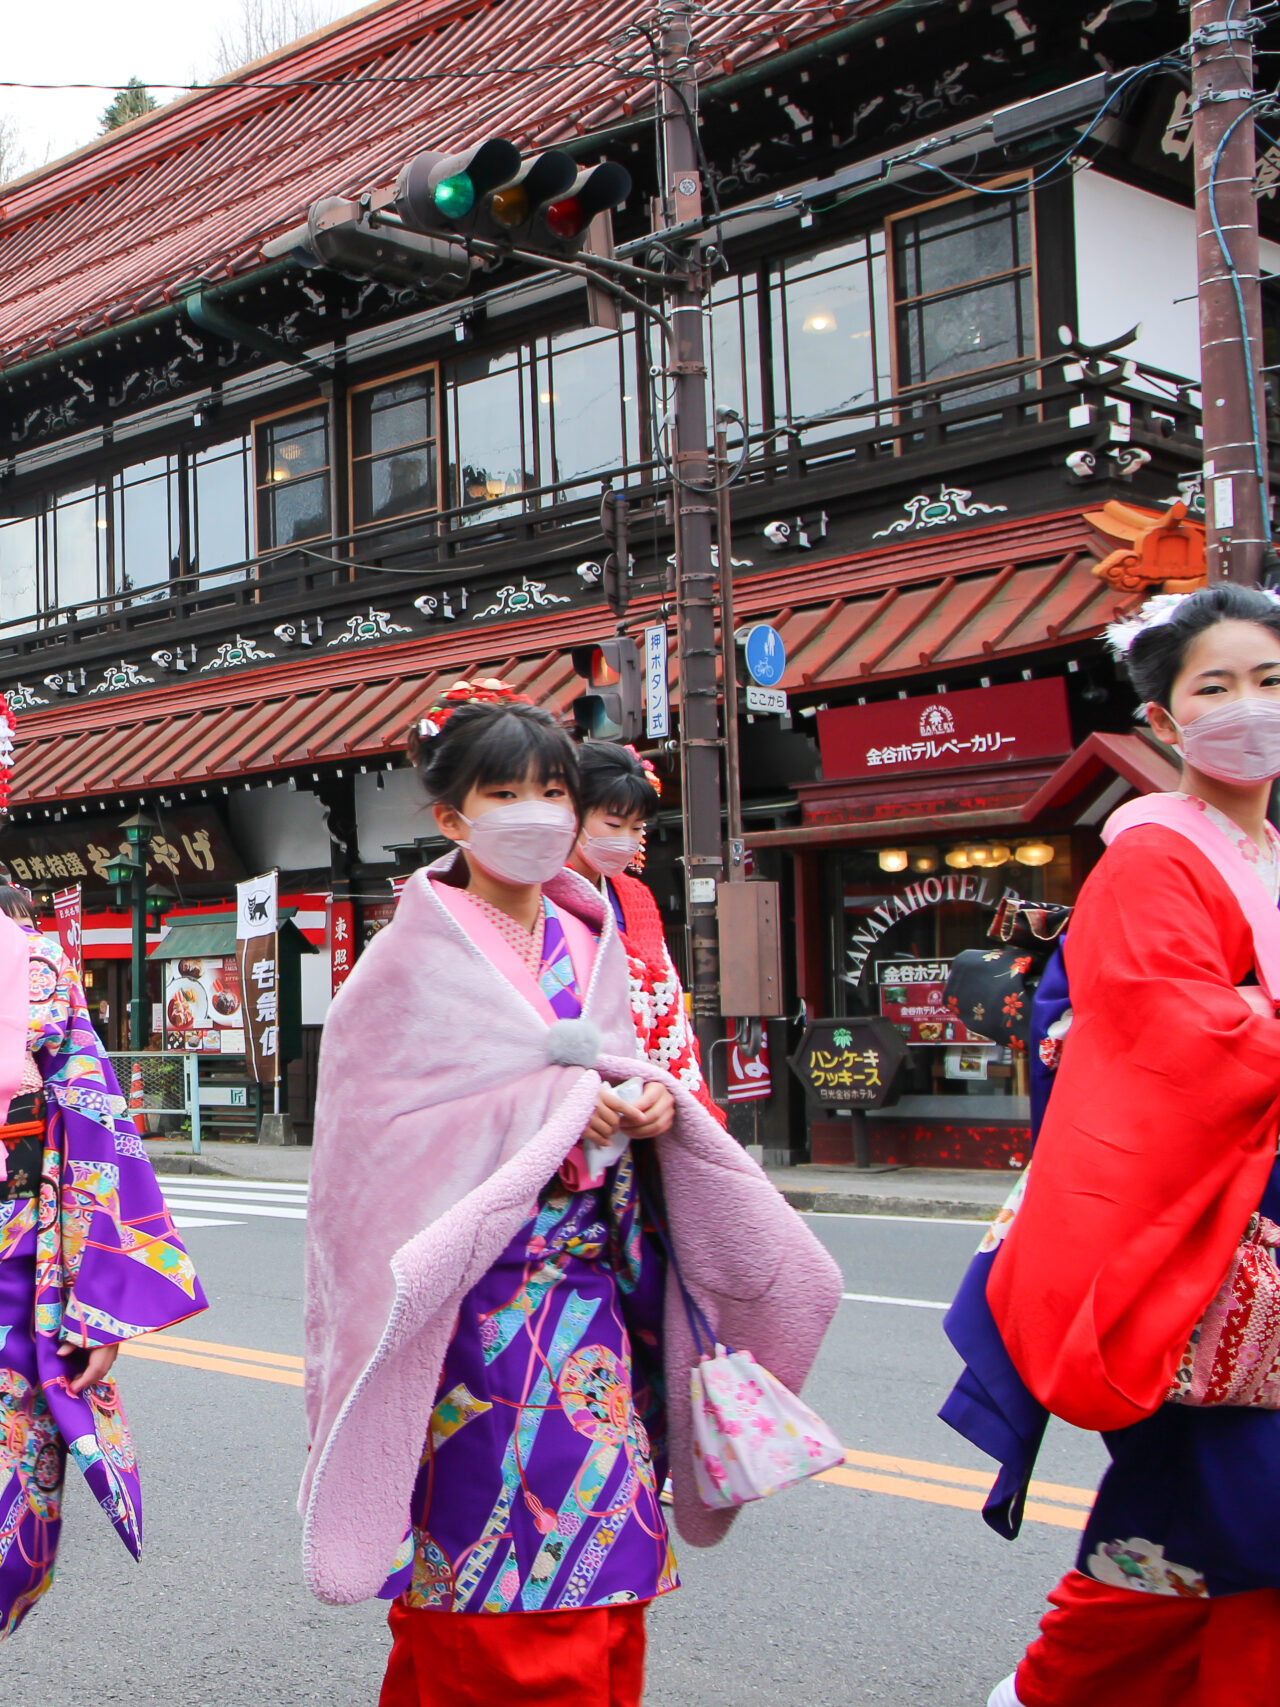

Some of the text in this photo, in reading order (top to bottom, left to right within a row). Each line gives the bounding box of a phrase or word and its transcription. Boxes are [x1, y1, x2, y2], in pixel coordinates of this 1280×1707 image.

[651, 634, 663, 730] 押ボタン式
[749, 692, 785, 708] ここから
[920, 722, 954, 735] BAKERY
[866, 732, 1016, 766] 金谷ホテルベーカリー
[87, 829, 215, 881] おやげ
[884, 964, 952, 982] 金谷ホテル
[820, 1089, 877, 1099] 日光金谷ホテル
